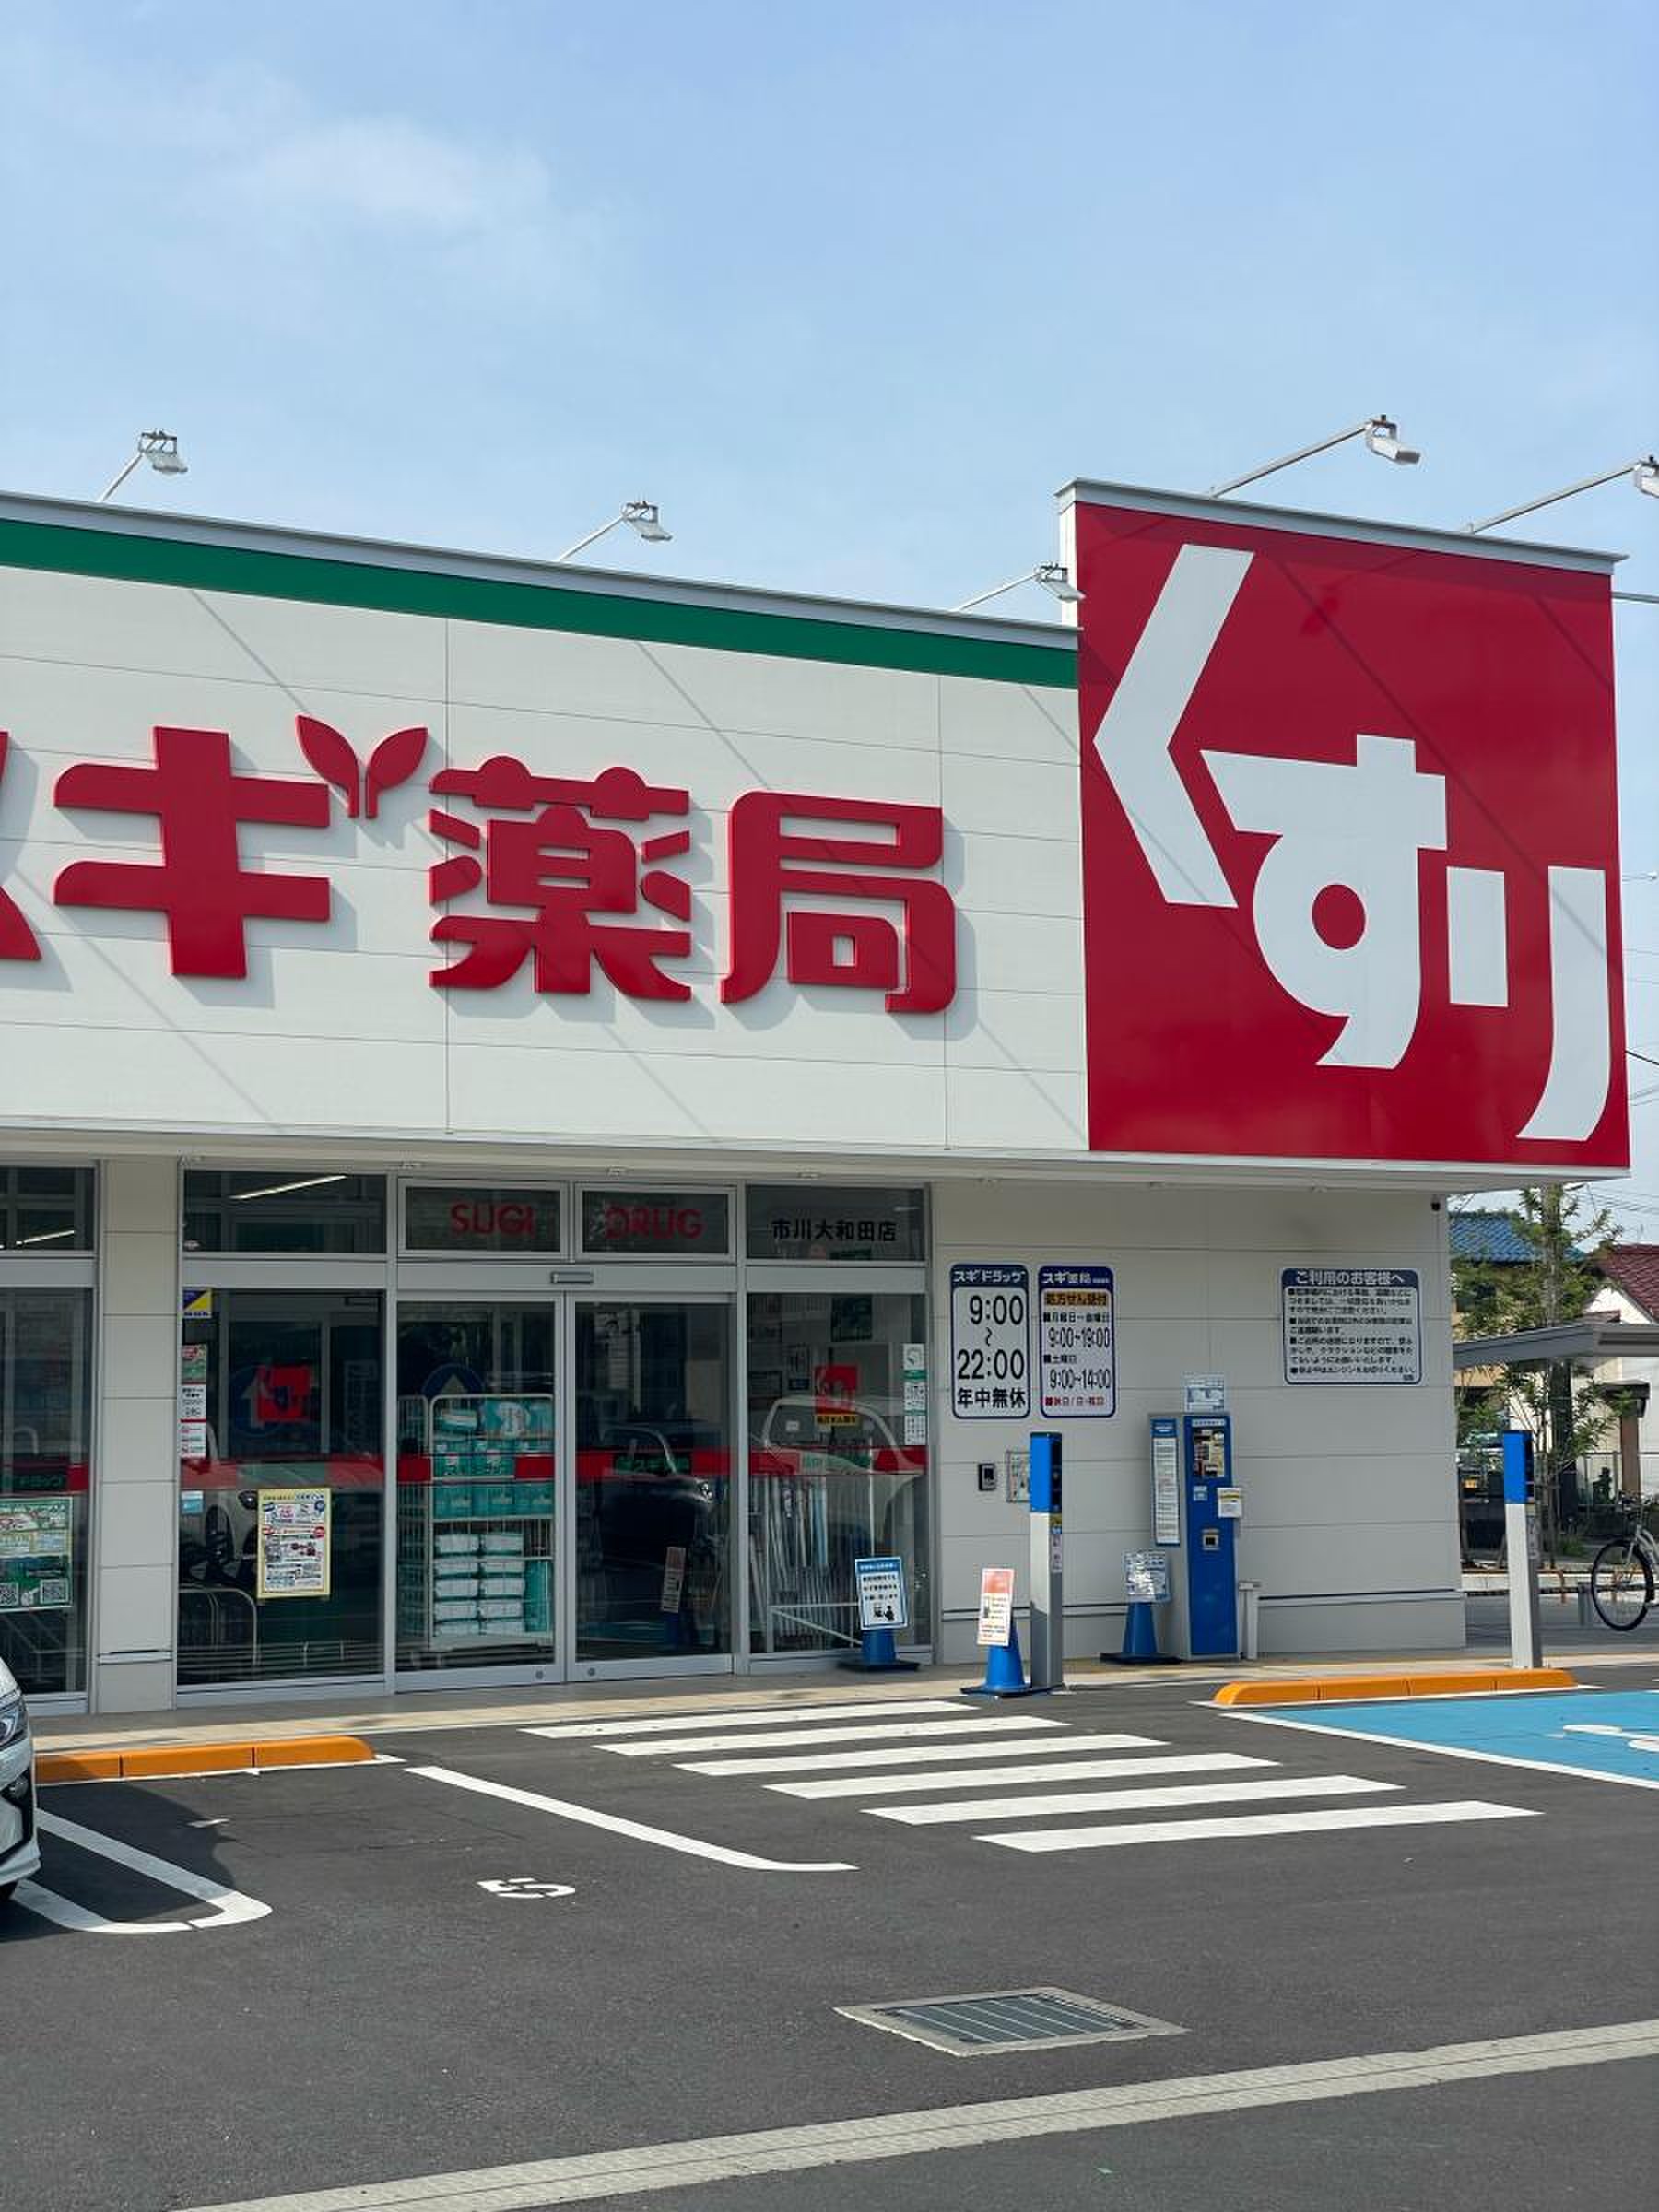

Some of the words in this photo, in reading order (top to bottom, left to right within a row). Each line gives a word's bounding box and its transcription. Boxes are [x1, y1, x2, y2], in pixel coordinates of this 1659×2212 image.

[1092, 542, 1612, 1143] くすり
[0, 714, 957, 1014] ギ薬局
[450, 1201, 535, 1239] SUGI
[605, 1206, 704, 1240] DRUG
[771, 1218, 897, 1241] 市川大和田店
[1295, 1270, 1405, 1285] ご利用のお客様へ
[970, 1294, 1025, 1325] 9:00
[957, 1348, 1025, 1381] 22:00
[958, 1387, 1027, 1409] 年中無休
